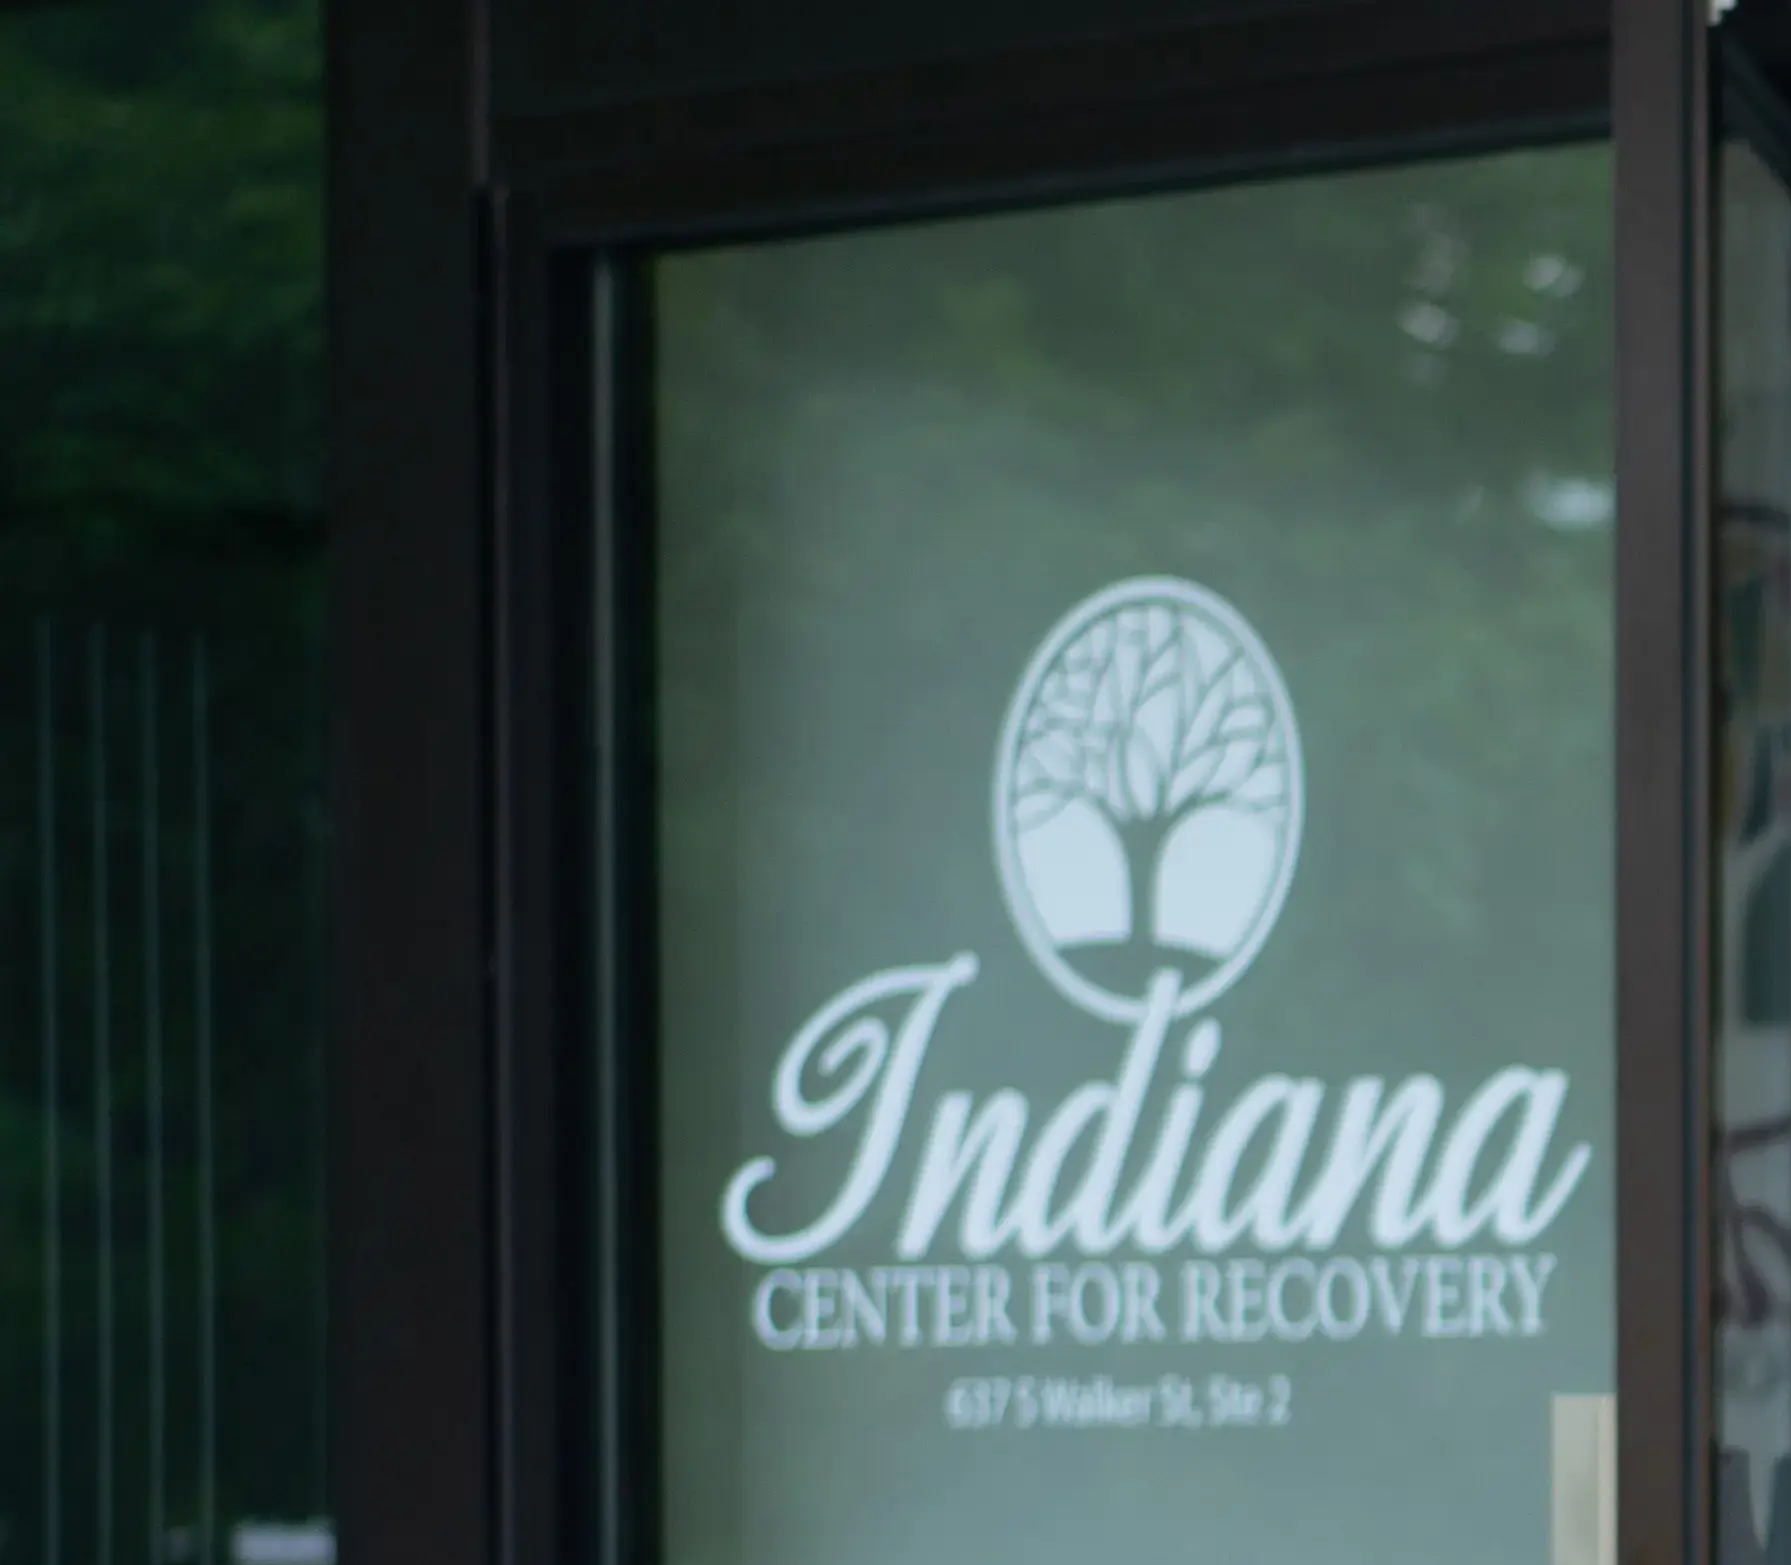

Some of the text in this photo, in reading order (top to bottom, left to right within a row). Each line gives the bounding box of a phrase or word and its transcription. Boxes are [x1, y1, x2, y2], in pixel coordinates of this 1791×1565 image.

[720, 953, 1590, 1262] Indiana
[753, 1252, 1558, 1351] CENTER FOR RECOVERY
[945, 1376, 1011, 1429] 637
[1014, 1375, 1037, 1429] S
[1041, 1373, 1151, 1428] Walker
[1208, 1373, 1262, 1428] Ste
[1268, 1374, 1291, 1426] 2
